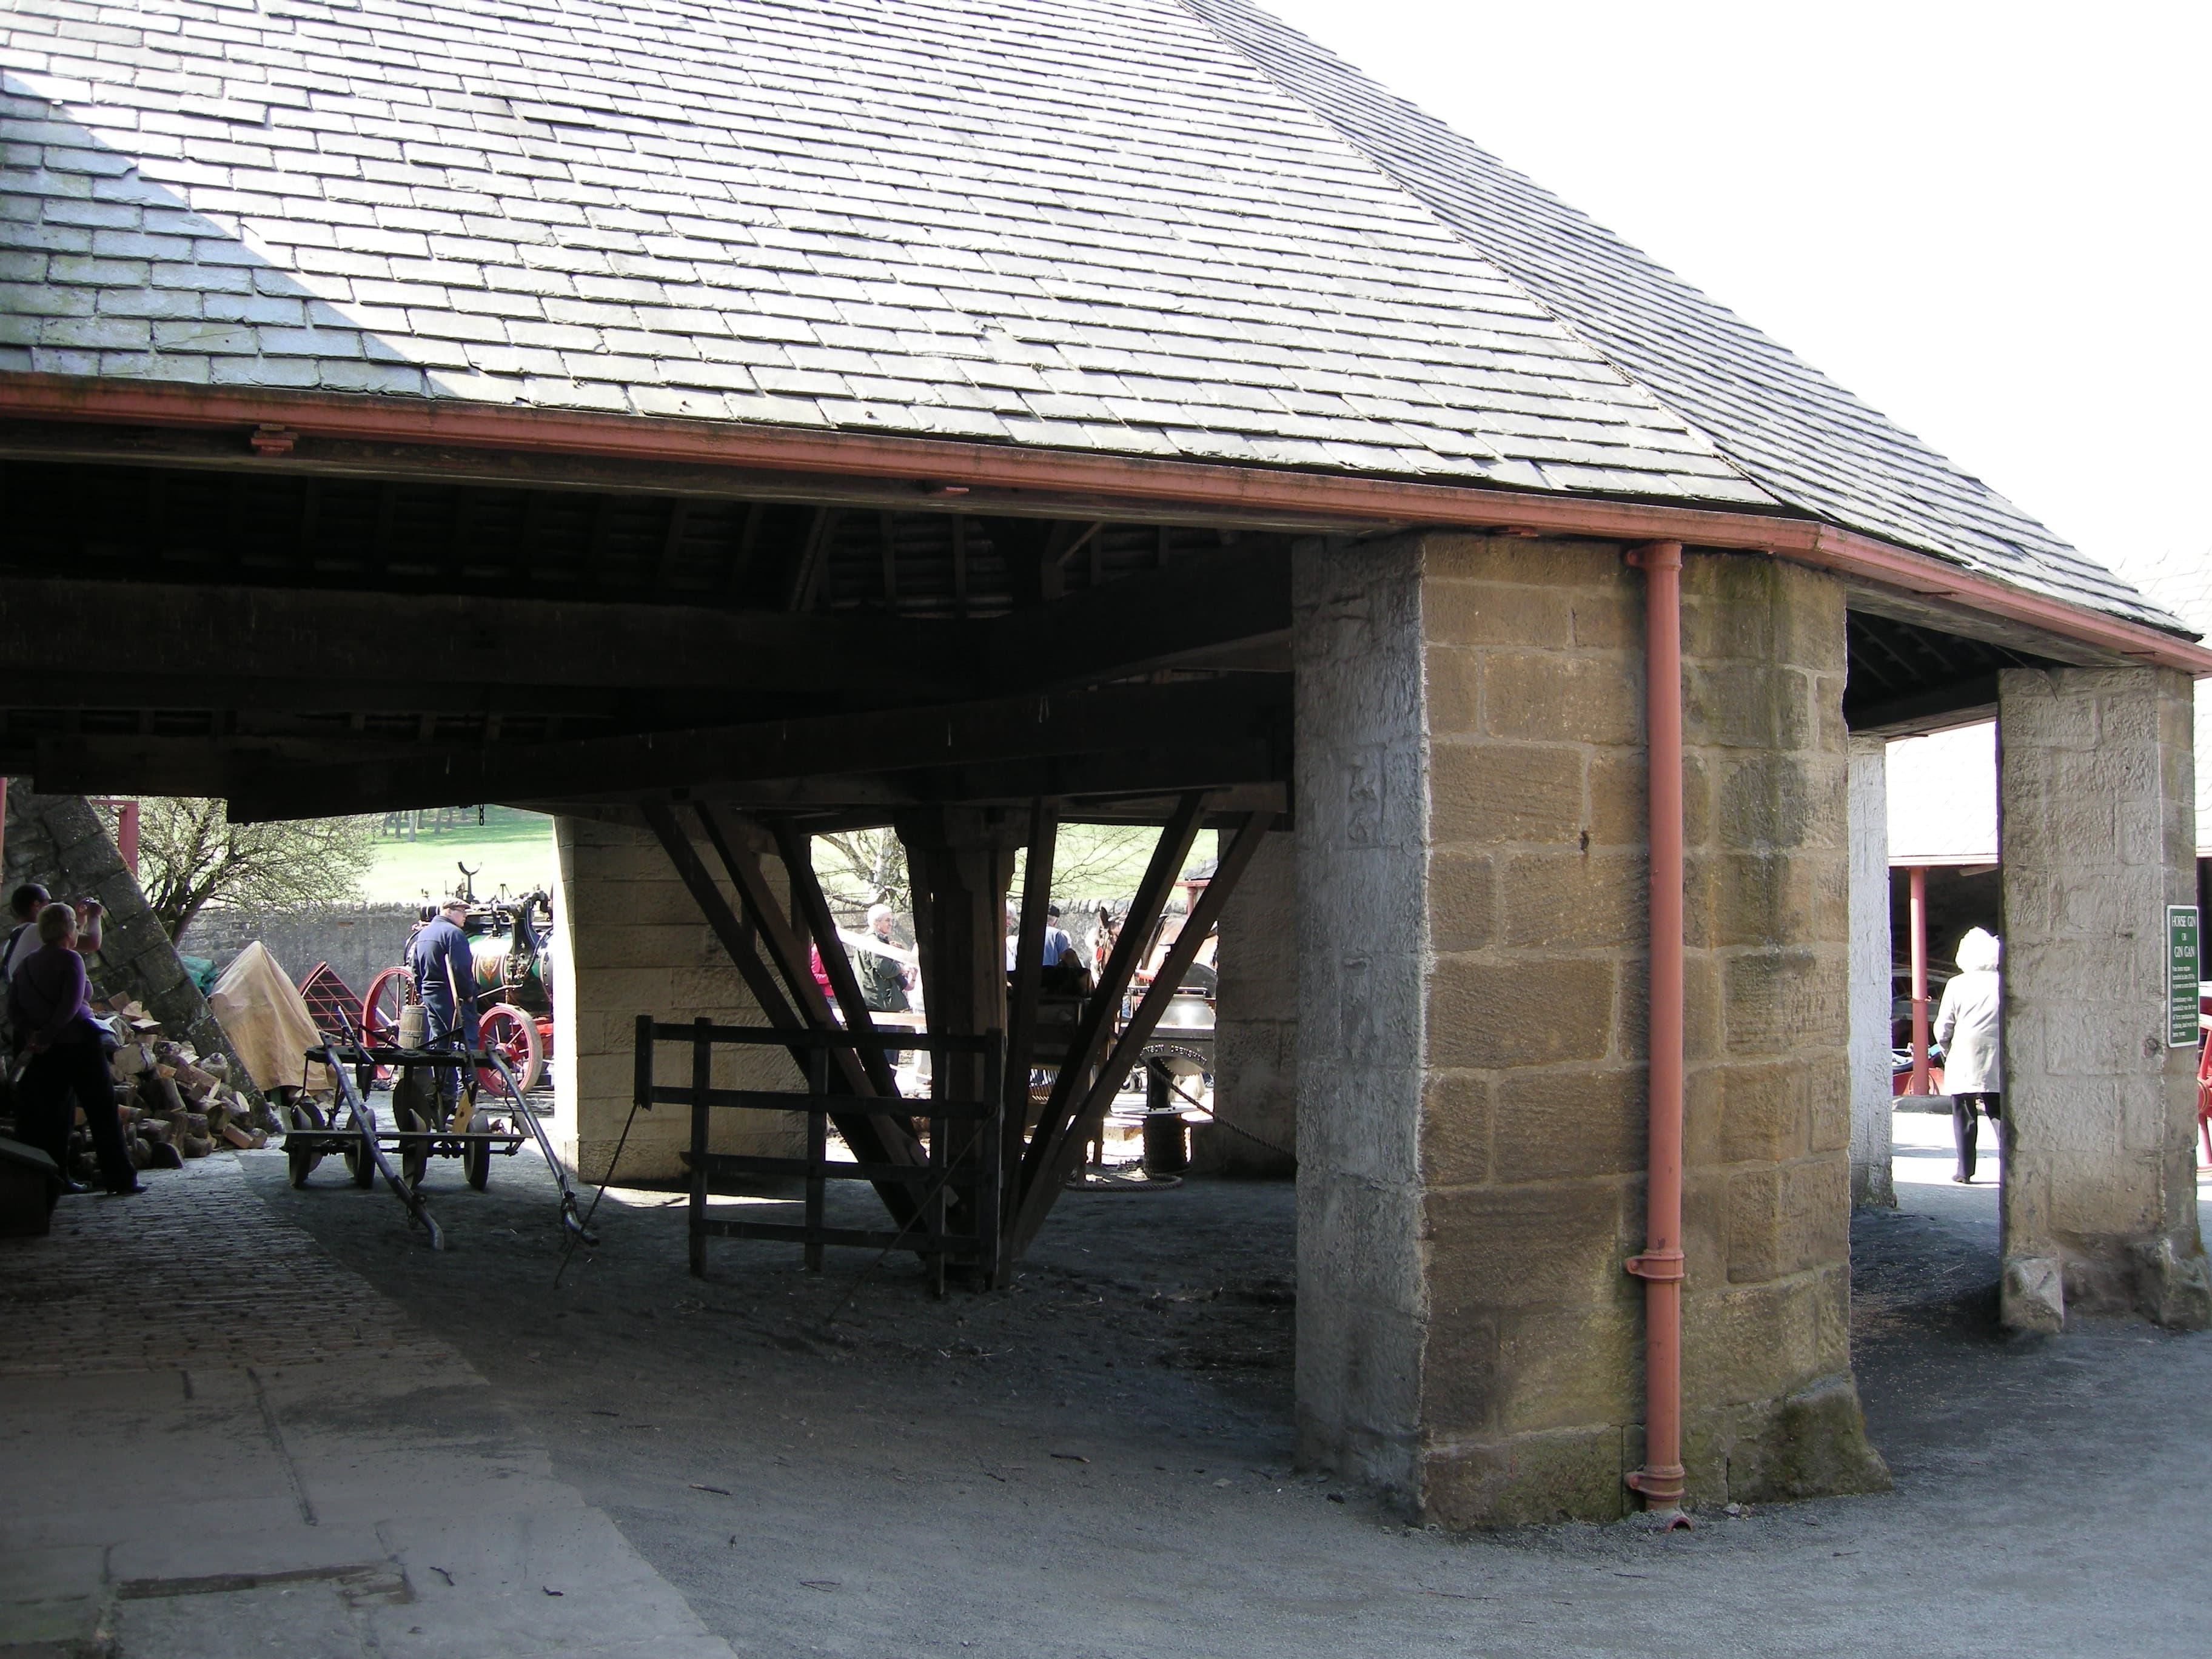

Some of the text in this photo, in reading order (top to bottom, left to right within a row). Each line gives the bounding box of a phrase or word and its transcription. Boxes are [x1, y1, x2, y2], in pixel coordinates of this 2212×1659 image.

[2171, 916, 2196, 927] HORSE GIN
[2174, 945, 2195, 957] GIN GAN
